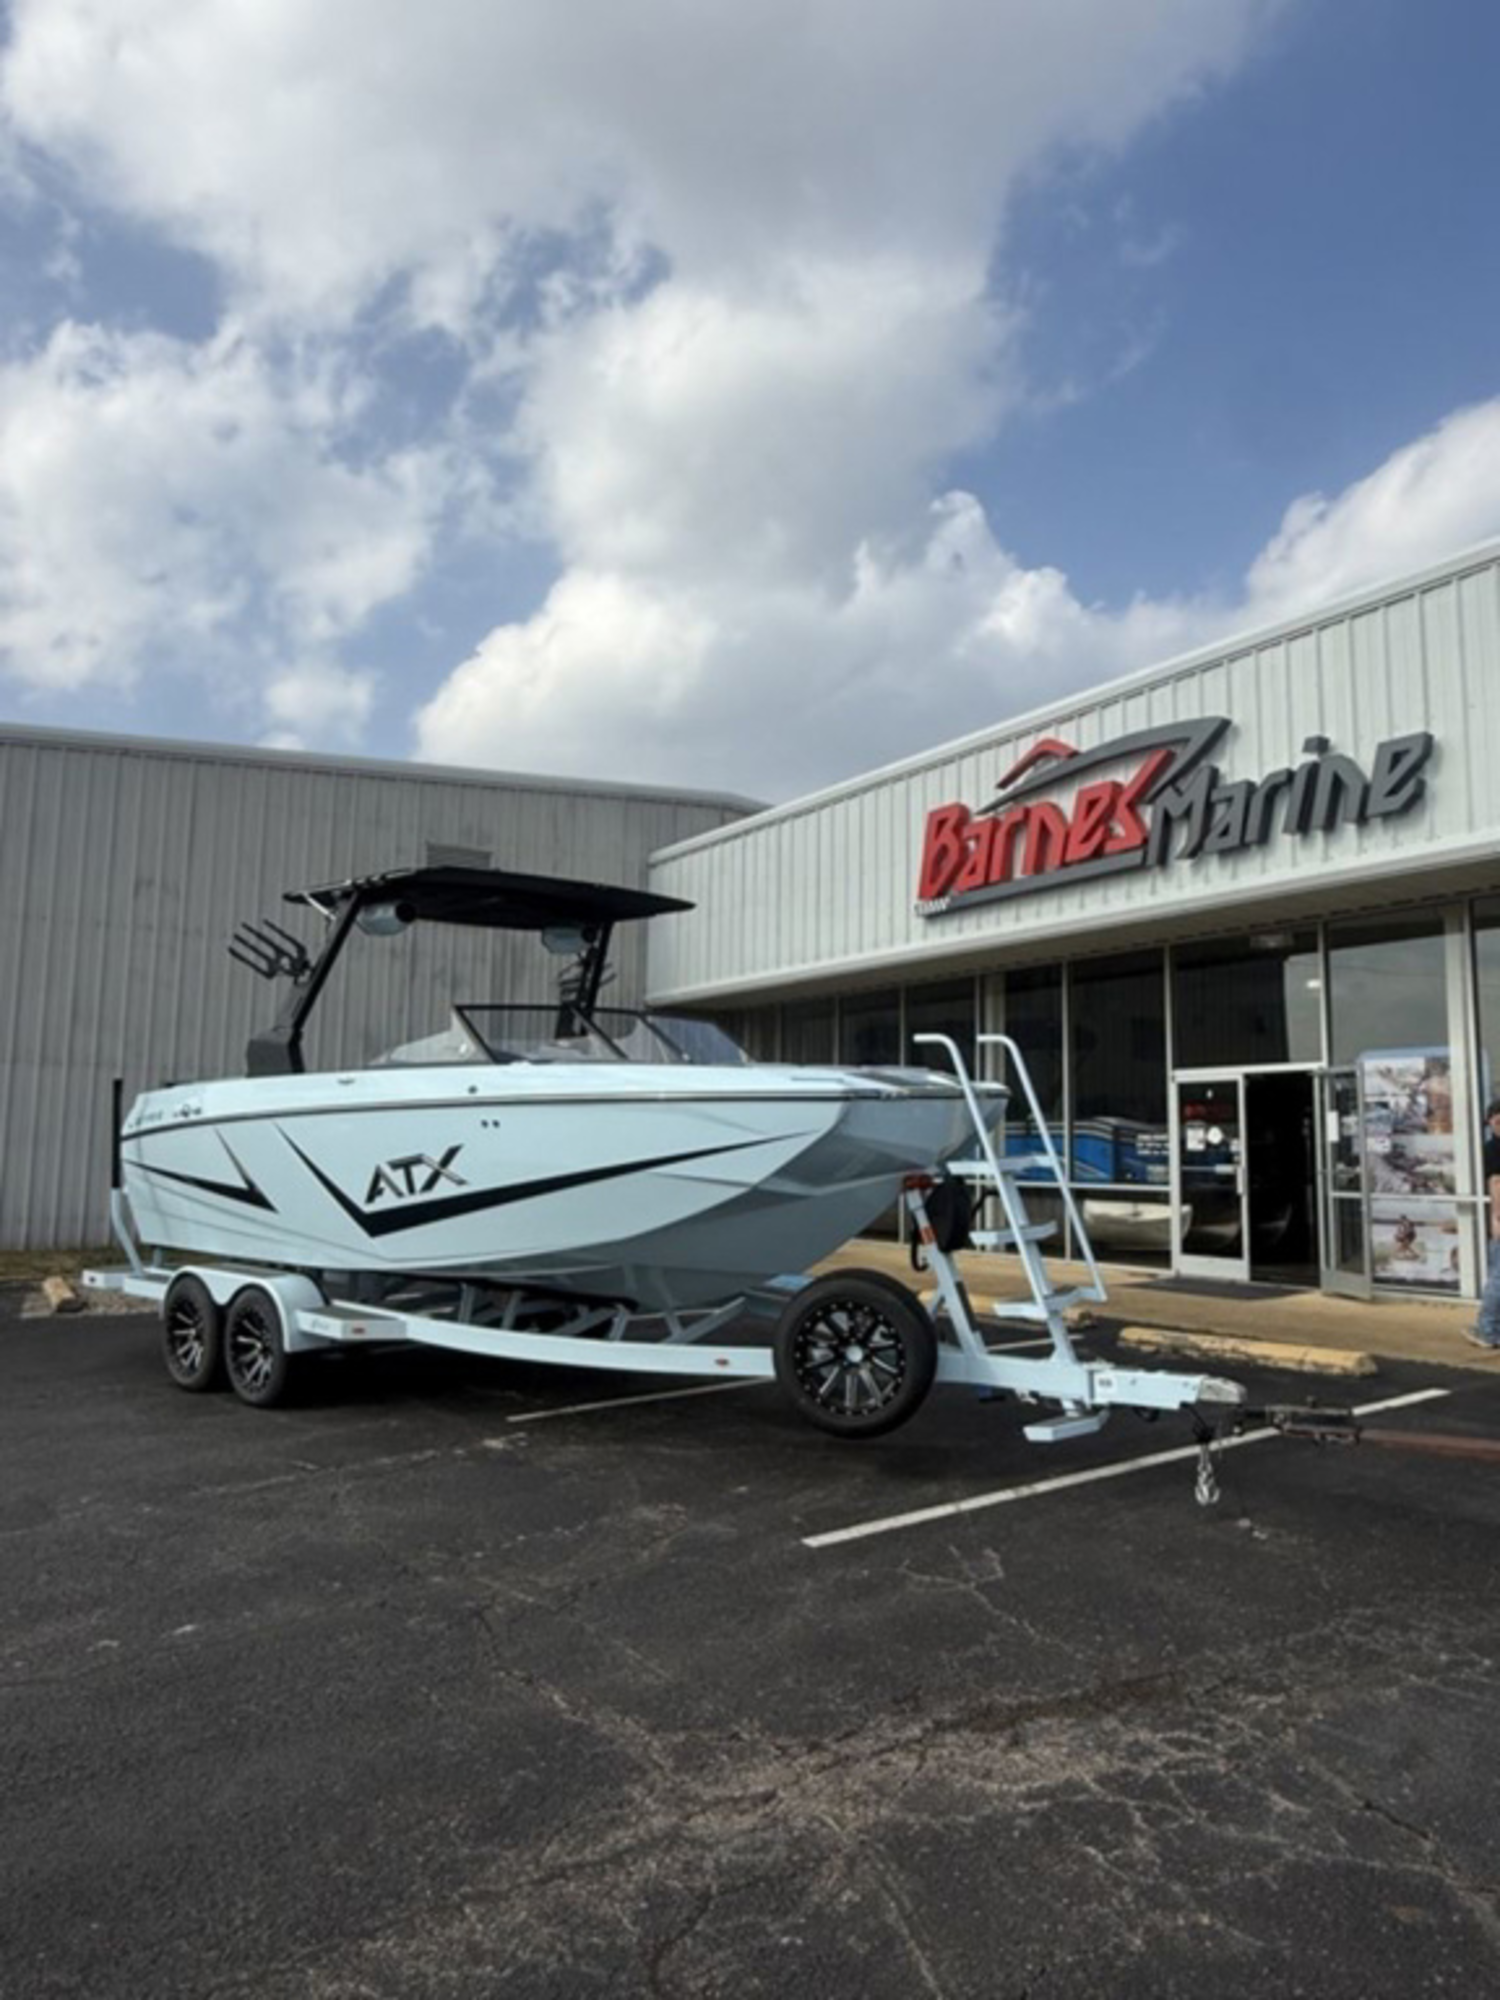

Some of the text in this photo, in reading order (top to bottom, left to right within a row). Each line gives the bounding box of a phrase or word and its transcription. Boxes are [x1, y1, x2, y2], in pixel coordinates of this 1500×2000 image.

[918, 732, 1434, 899] Barnes Marine
[364, 1143, 469, 1205] ATX
